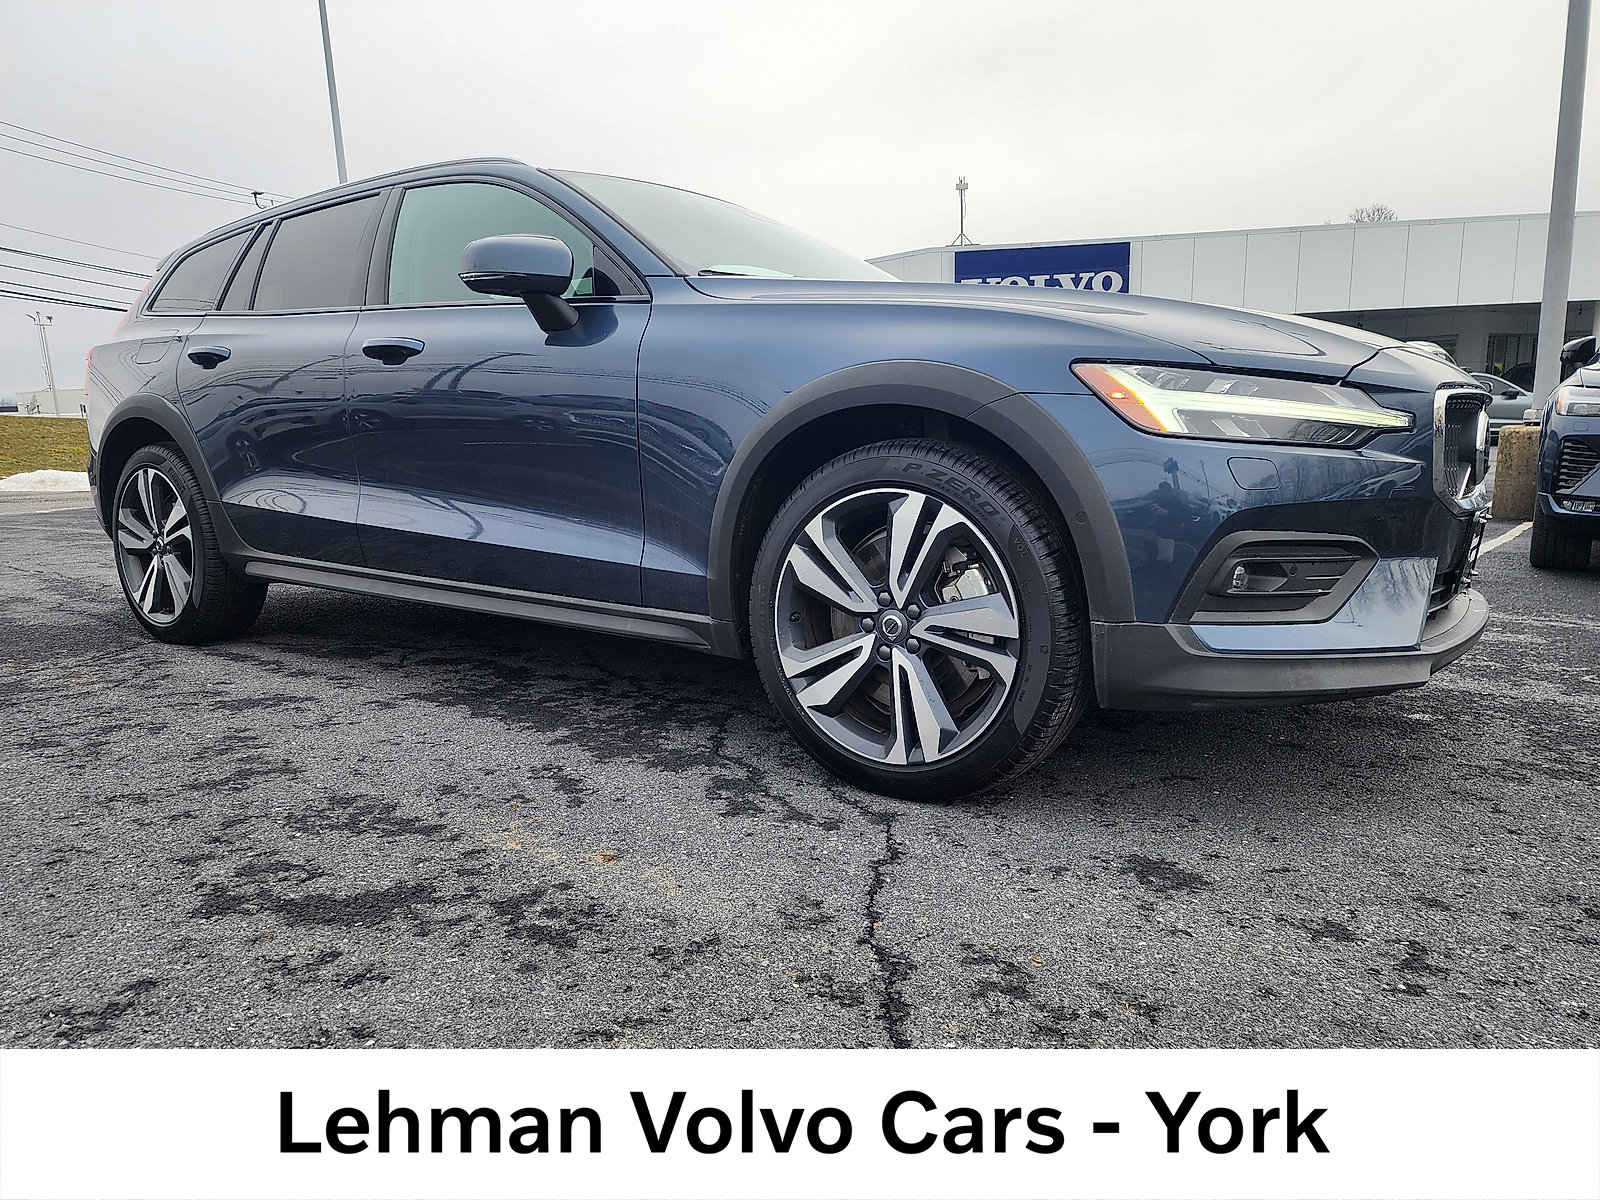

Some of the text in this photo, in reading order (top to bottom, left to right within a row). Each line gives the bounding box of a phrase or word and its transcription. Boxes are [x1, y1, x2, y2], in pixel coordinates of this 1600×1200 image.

[959, 270, 1124, 293] LVO
[902, 462, 1001, 517] P ZERO
[1013, 536, 1028, 558] VOL
